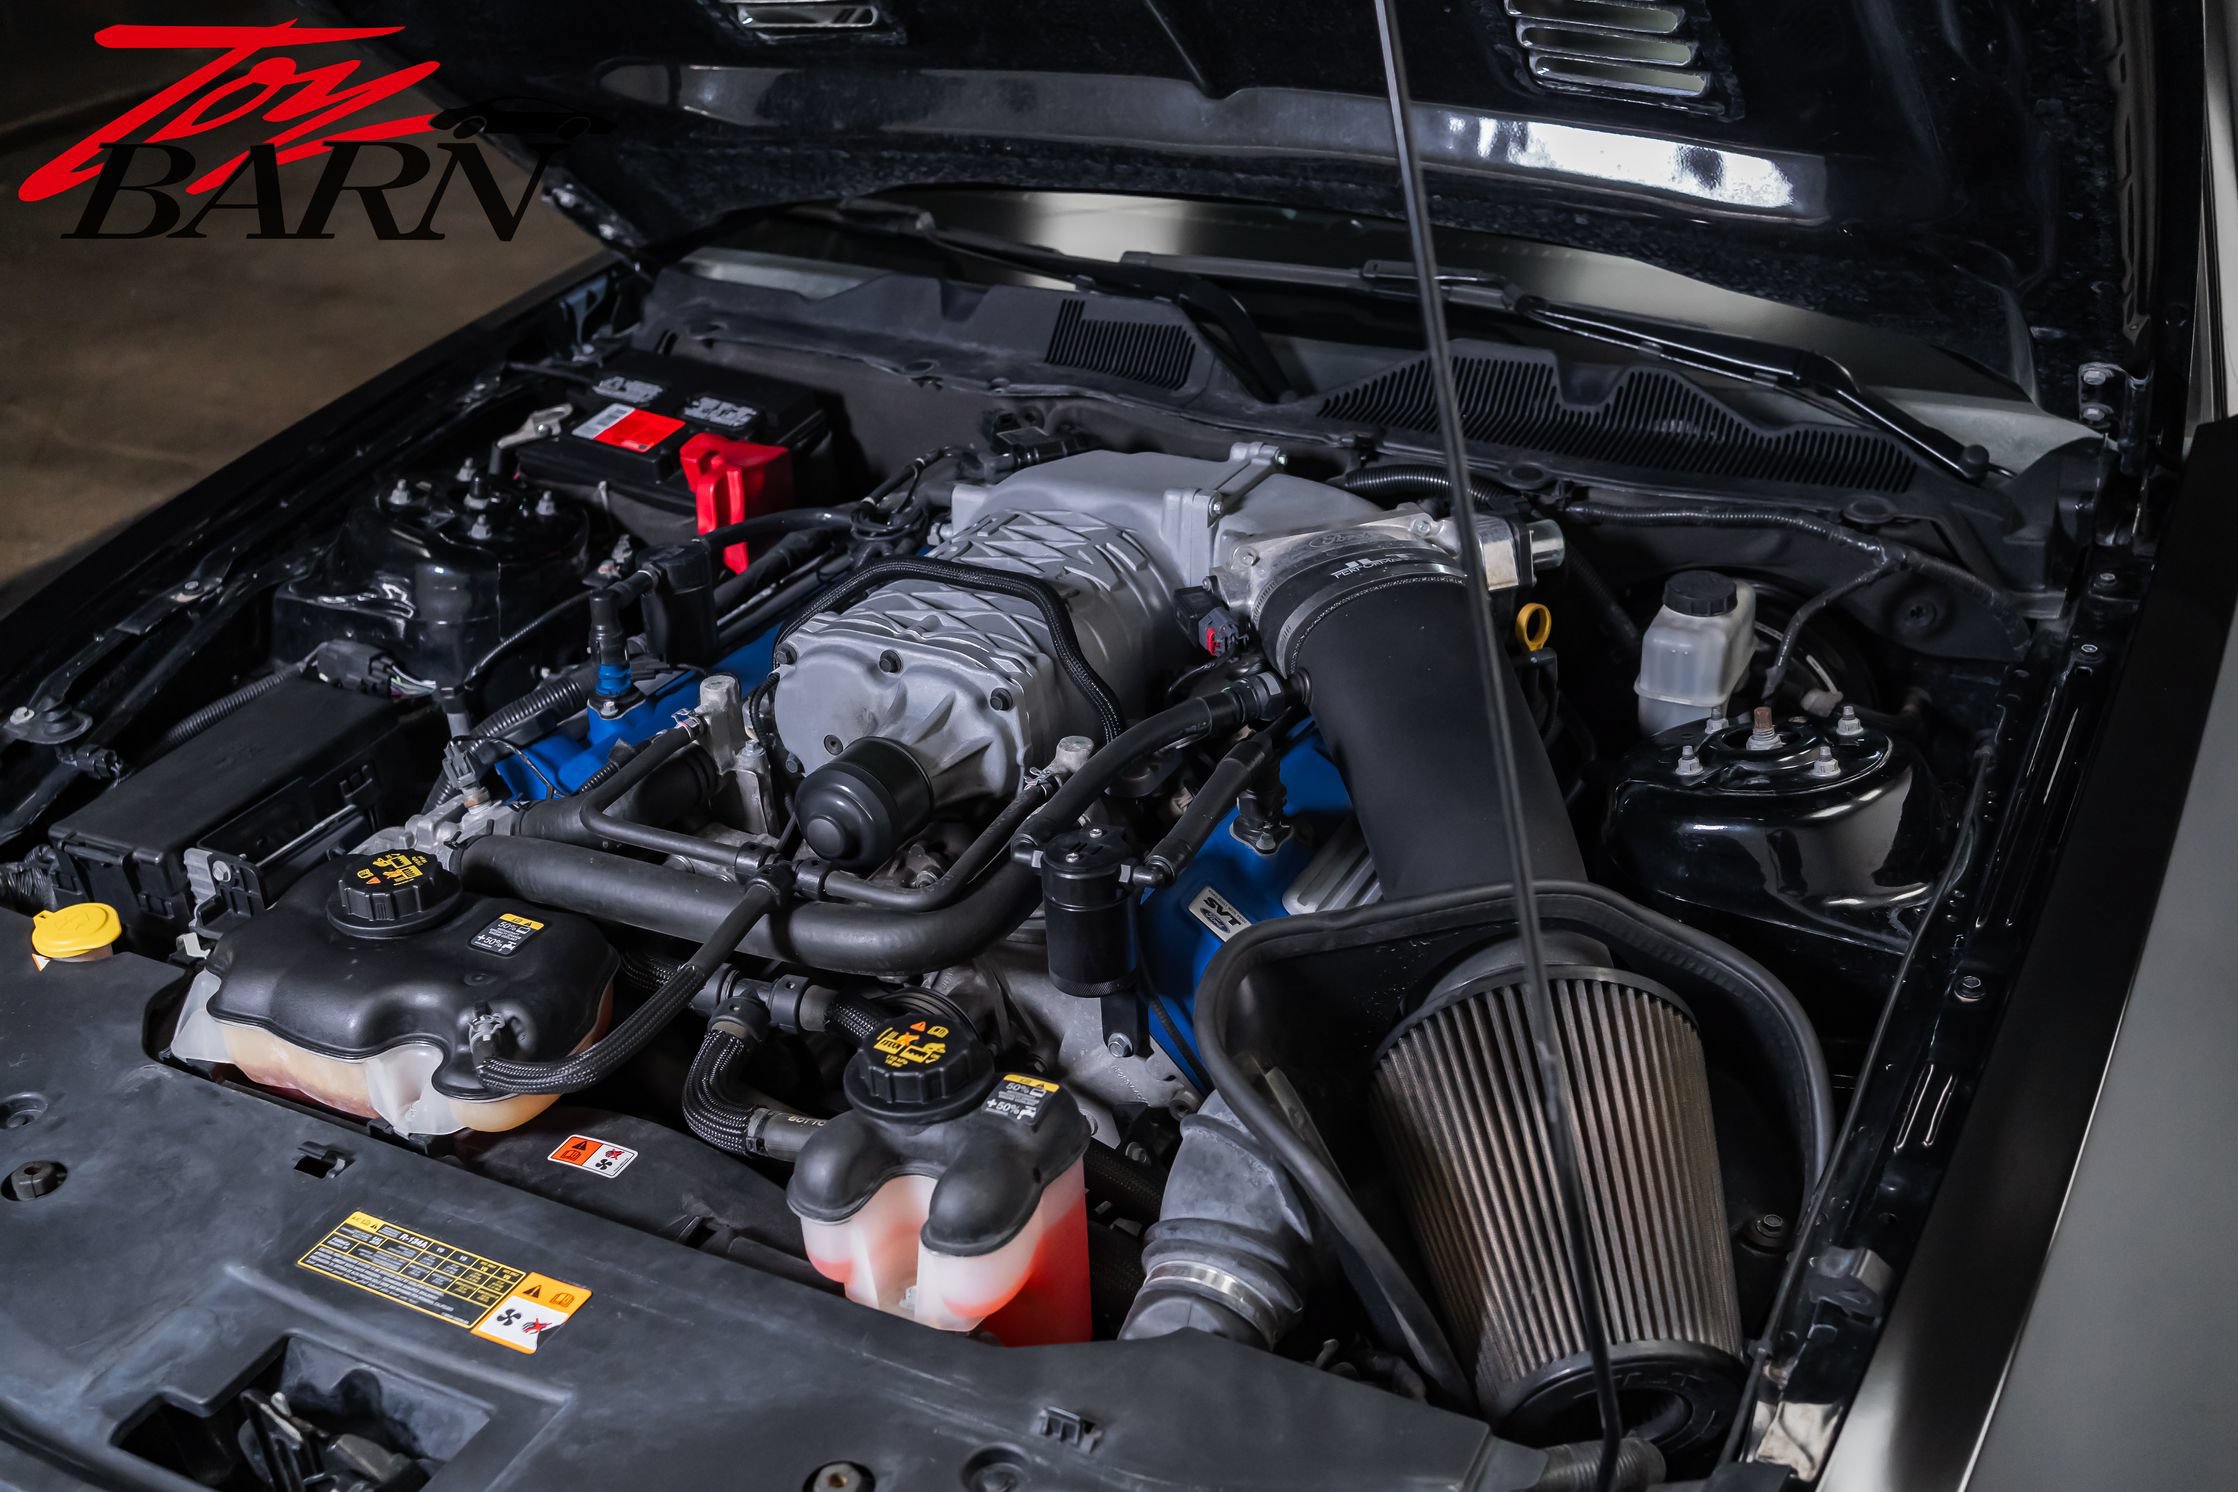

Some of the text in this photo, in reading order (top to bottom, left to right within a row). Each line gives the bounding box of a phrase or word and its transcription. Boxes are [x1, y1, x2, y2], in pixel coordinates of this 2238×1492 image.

[1203, 896, 1242, 926] SVT
[497, 921, 518, 931] 50%
[1005, 1082, 1029, 1094] 50%
[398, 1233, 429, 1249] R-134A
